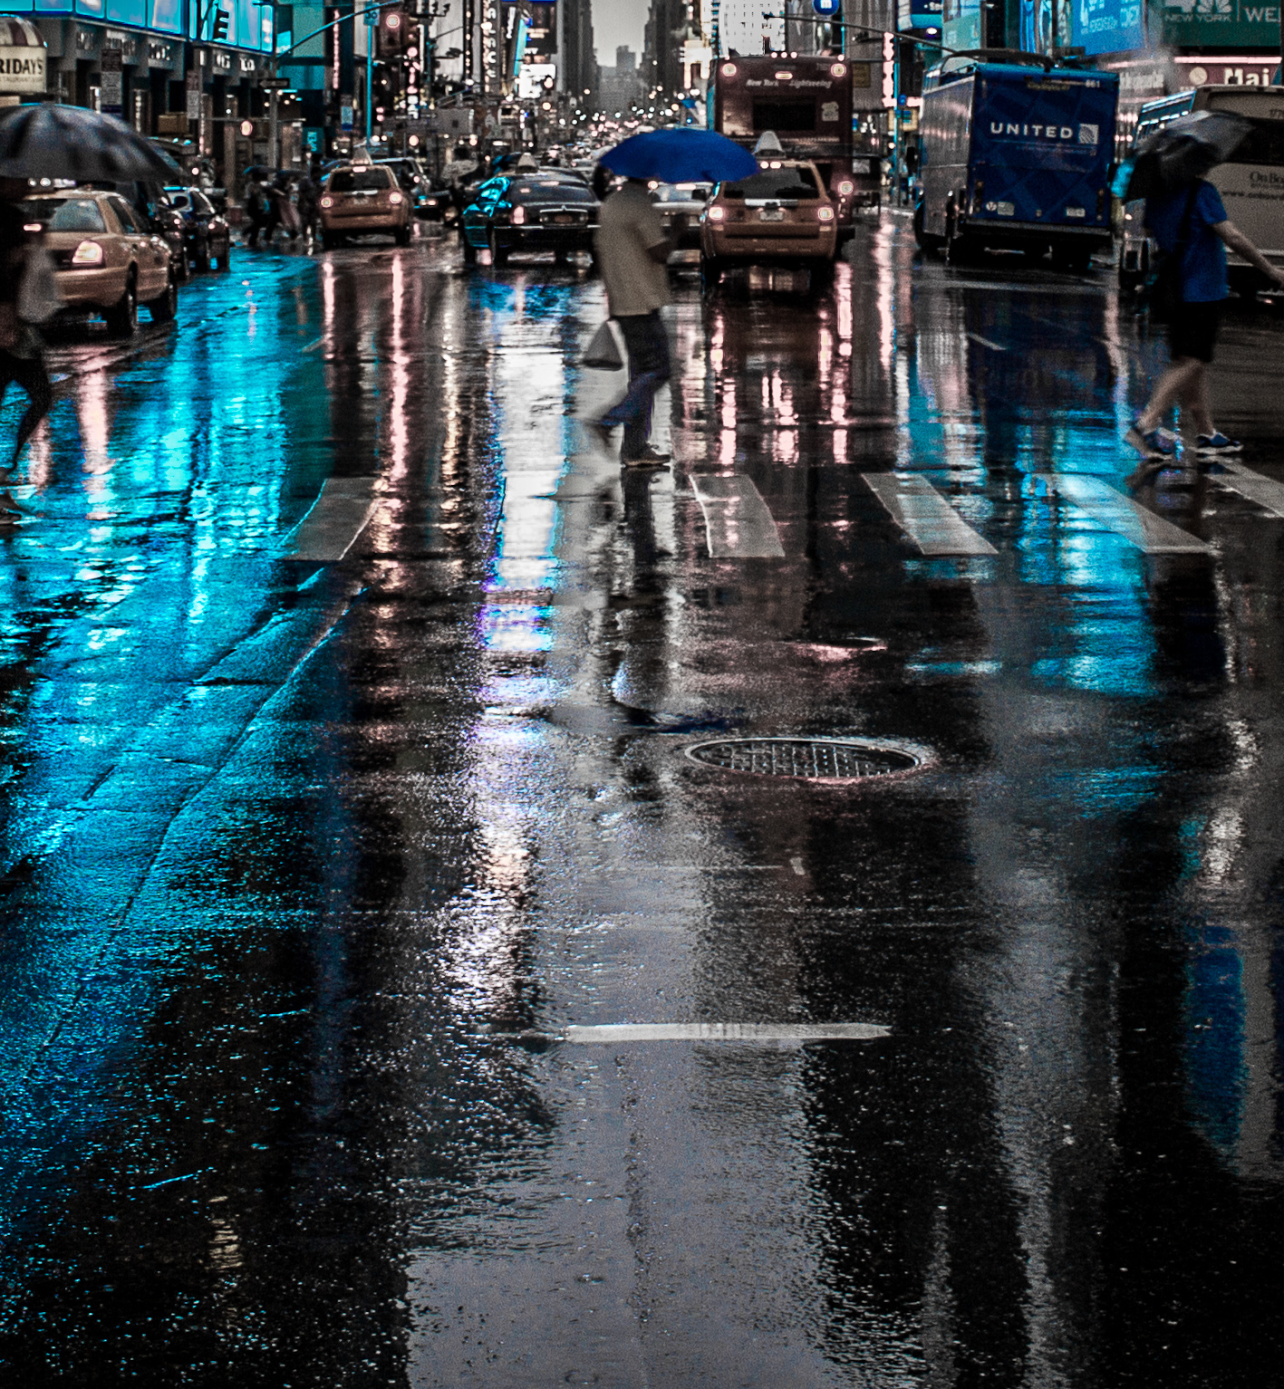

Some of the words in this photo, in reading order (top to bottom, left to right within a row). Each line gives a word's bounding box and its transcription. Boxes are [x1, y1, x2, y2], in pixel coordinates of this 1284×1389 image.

[1164, 13, 1193, 23] NEW
[1196, 13, 1232, 23] YORK
[990, 122, 1074, 140] UNITED
